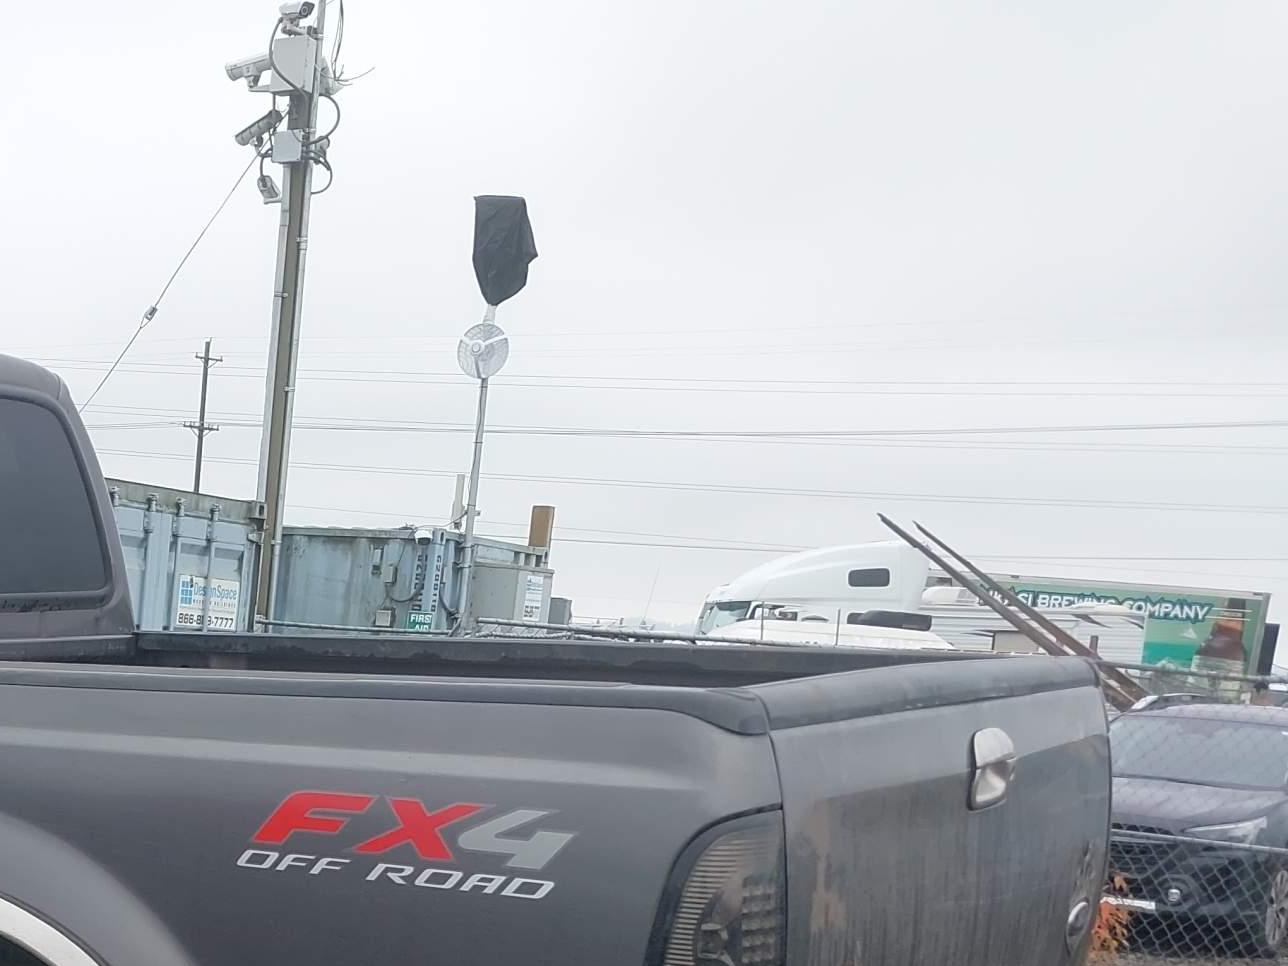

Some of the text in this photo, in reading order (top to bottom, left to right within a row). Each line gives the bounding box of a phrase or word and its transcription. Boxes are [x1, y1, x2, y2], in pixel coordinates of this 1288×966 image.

[193, 582, 238, 601] DesnSpace
[1122, 600, 1210, 620] COMPANY
[251, 790, 580, 870] FX4
[235, 848, 556, 900] OFF ROAD
